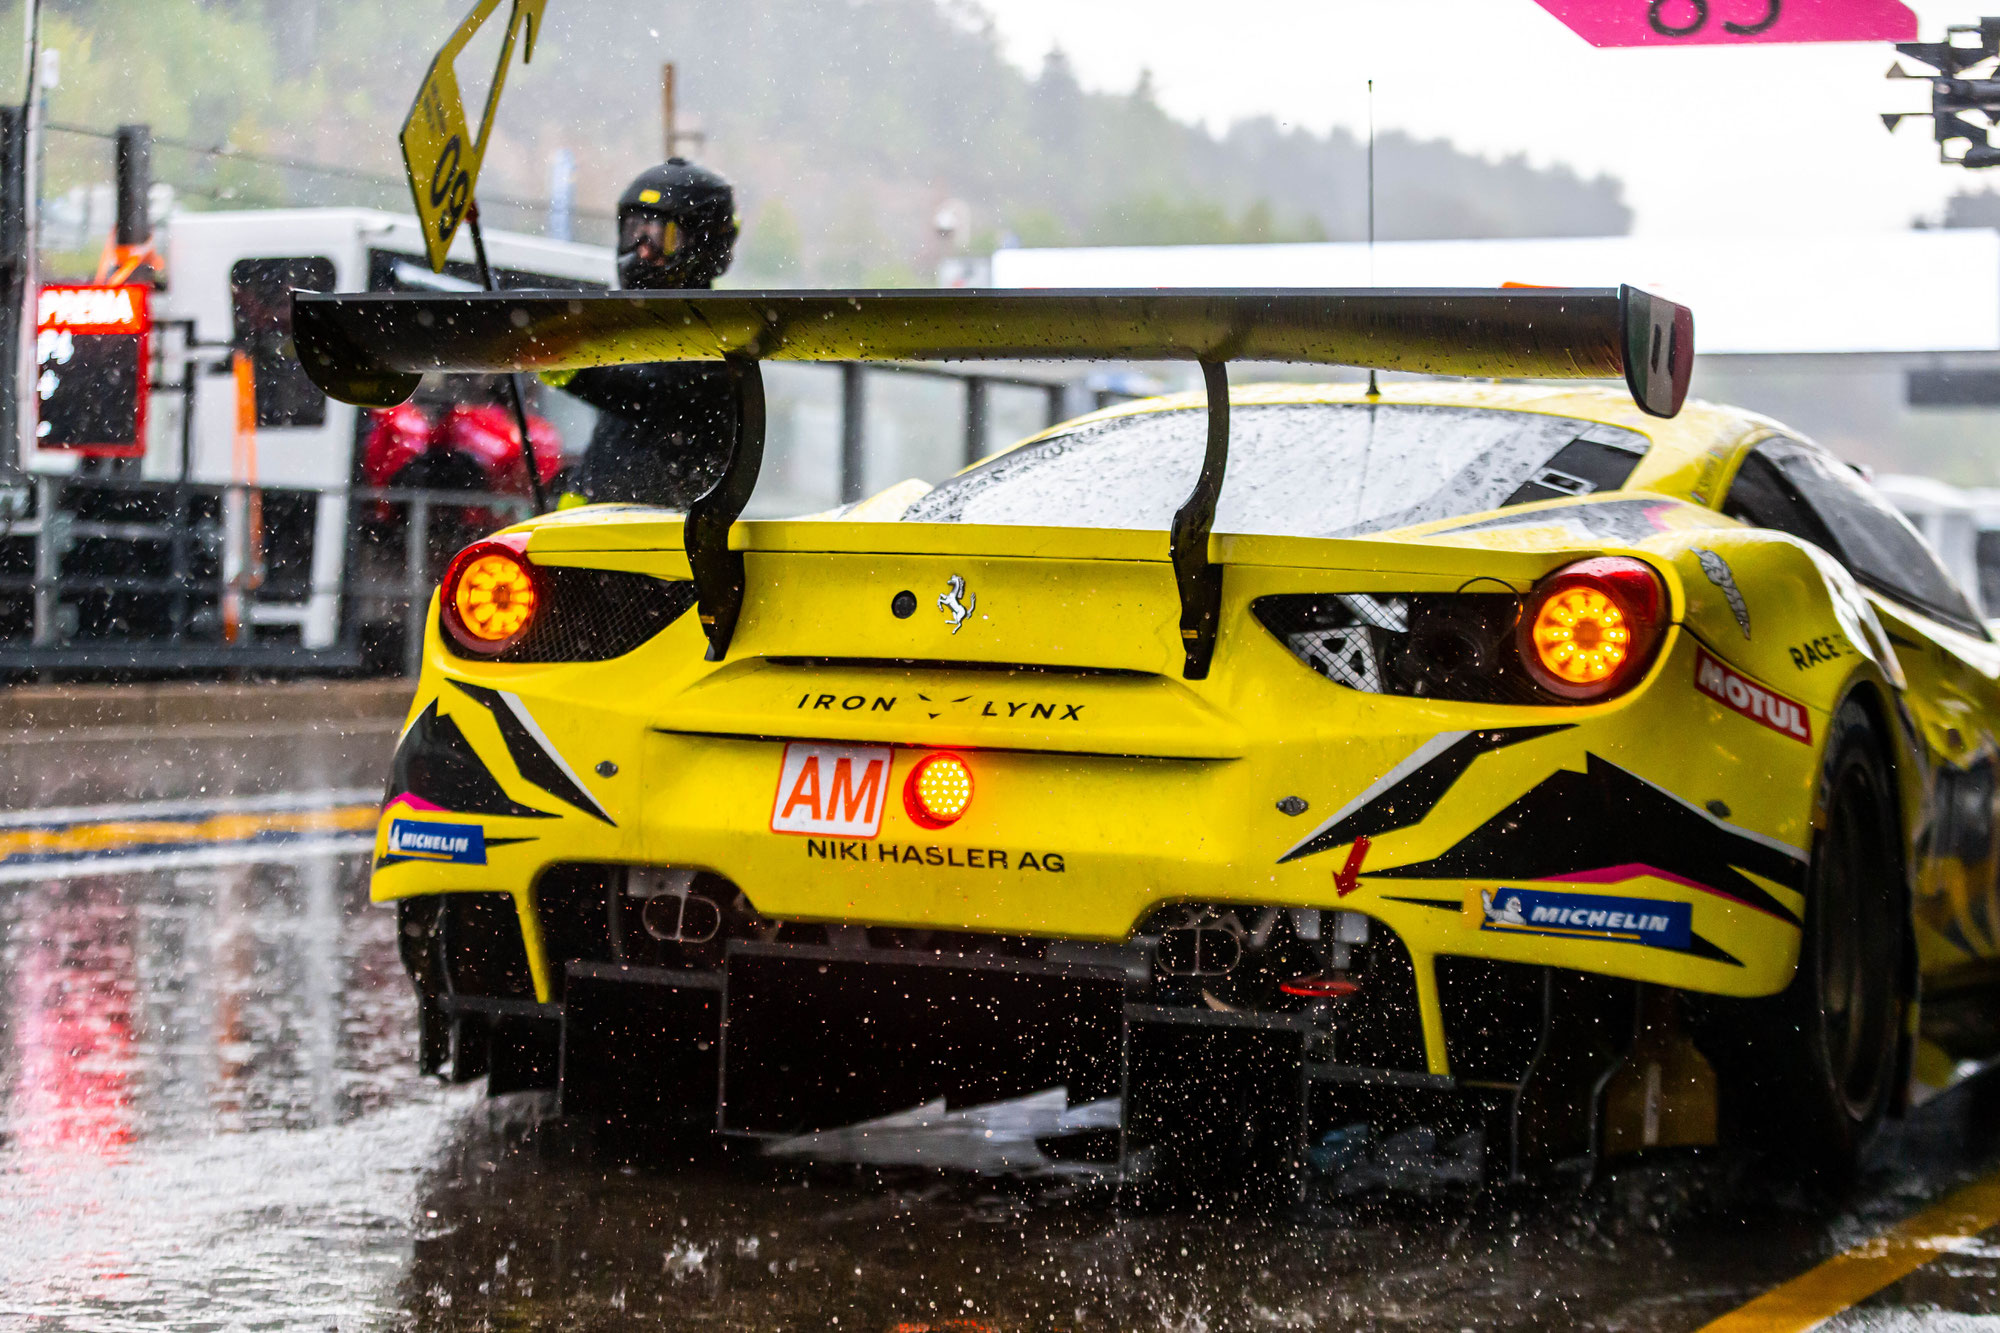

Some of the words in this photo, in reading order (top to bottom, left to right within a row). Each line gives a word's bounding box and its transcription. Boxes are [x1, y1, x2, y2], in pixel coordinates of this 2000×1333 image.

[1789, 636, 1841, 671] RACE
[797, 693, 897, 712] IRON
[981, 701, 1086, 721] LYNX
[1700, 658, 1807, 738] MOTUL
[780, 755, 884, 824] AM
[400, 832, 469, 853] MICHELIN
[807, 839, 868, 862] NIKI
[878, 843, 1009, 869] HASLER
[1018, 852, 1066, 873] AG
[1530, 905, 1670, 932] MICHELIN
